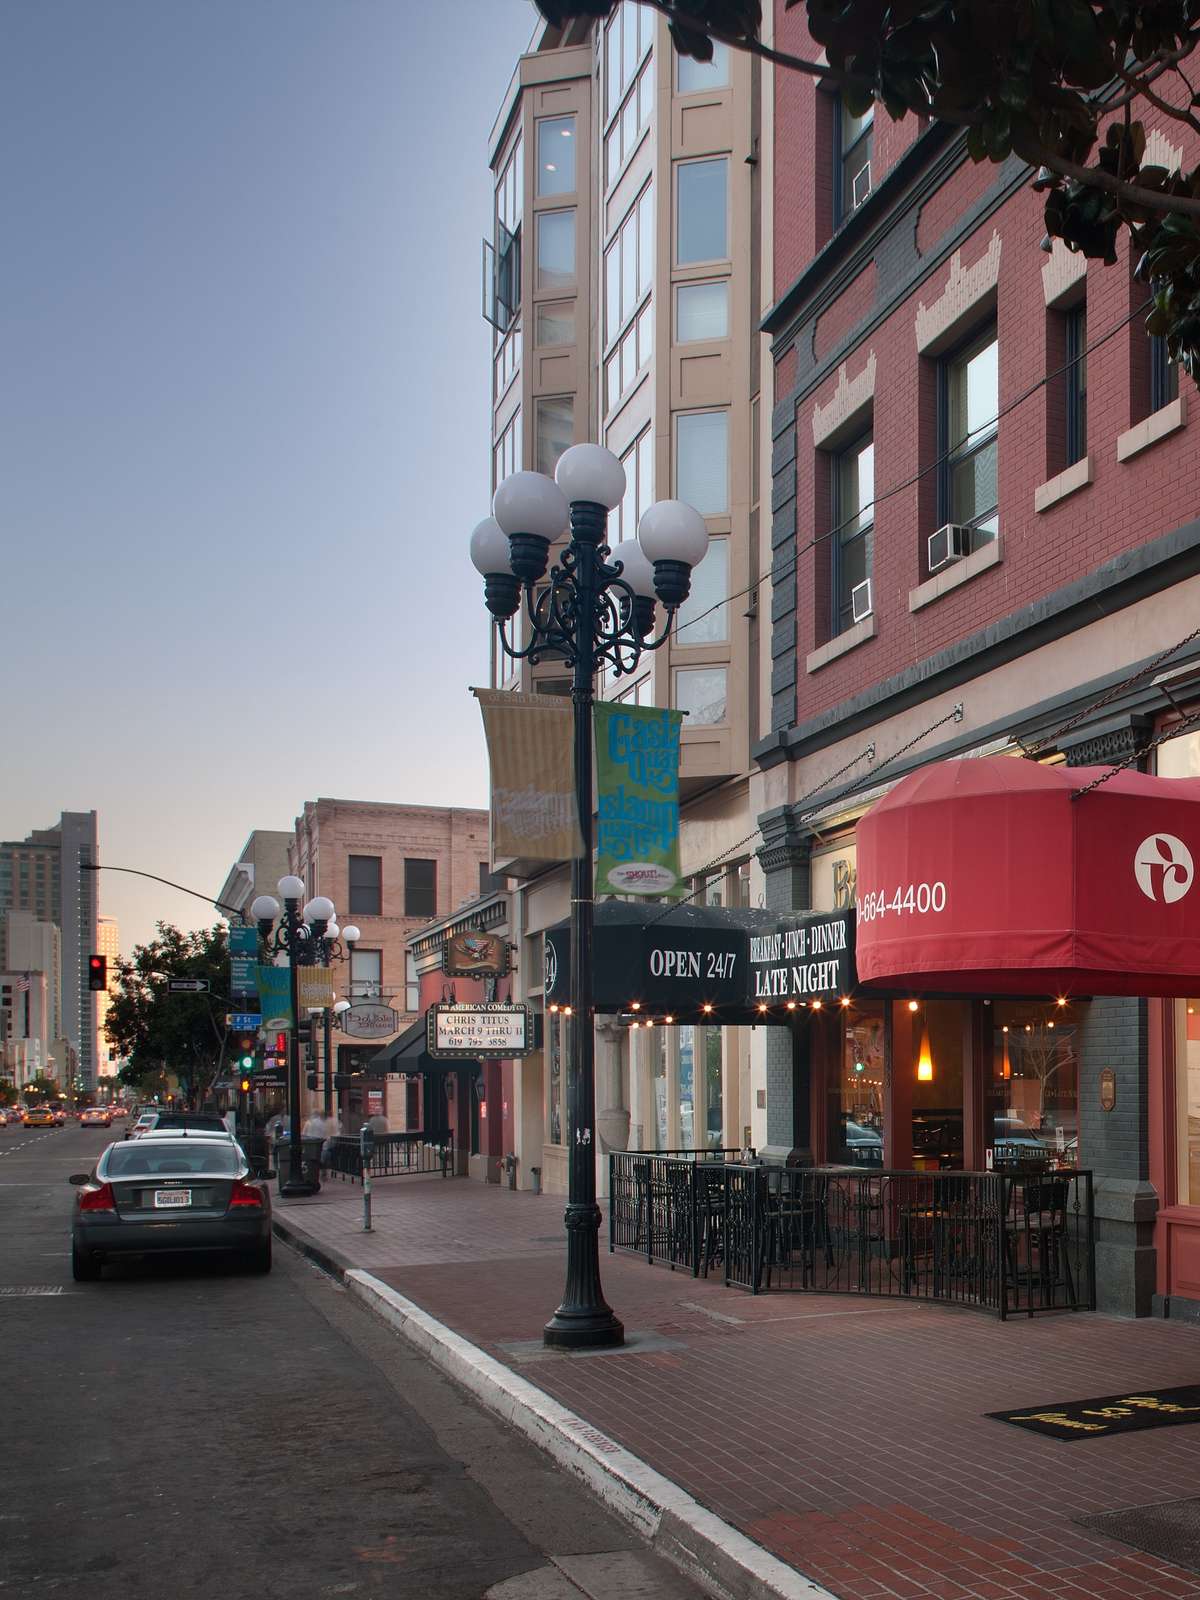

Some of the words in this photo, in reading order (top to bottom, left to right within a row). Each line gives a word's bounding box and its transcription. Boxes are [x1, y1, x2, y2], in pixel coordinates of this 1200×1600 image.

[750, 933, 782, 963] BREAKFAST
[784, 927, 806, 959] LUNCH
[811, 919, 847, 955] DINNER
[650, 949, 700, 978] OPEN
[707, 952, 737, 979] 24/7
[755, 966, 788, 997] LATE
[792, 959, 841, 994] NIGHT
[438, 1027, 475, 1036] MARCH
[477, 1027, 483, 1036] 9
[486, 1027, 512, 1036] THRU
[446, 1016, 477, 1025] CHRIS
[481, 1016, 510, 1025] TITUS
